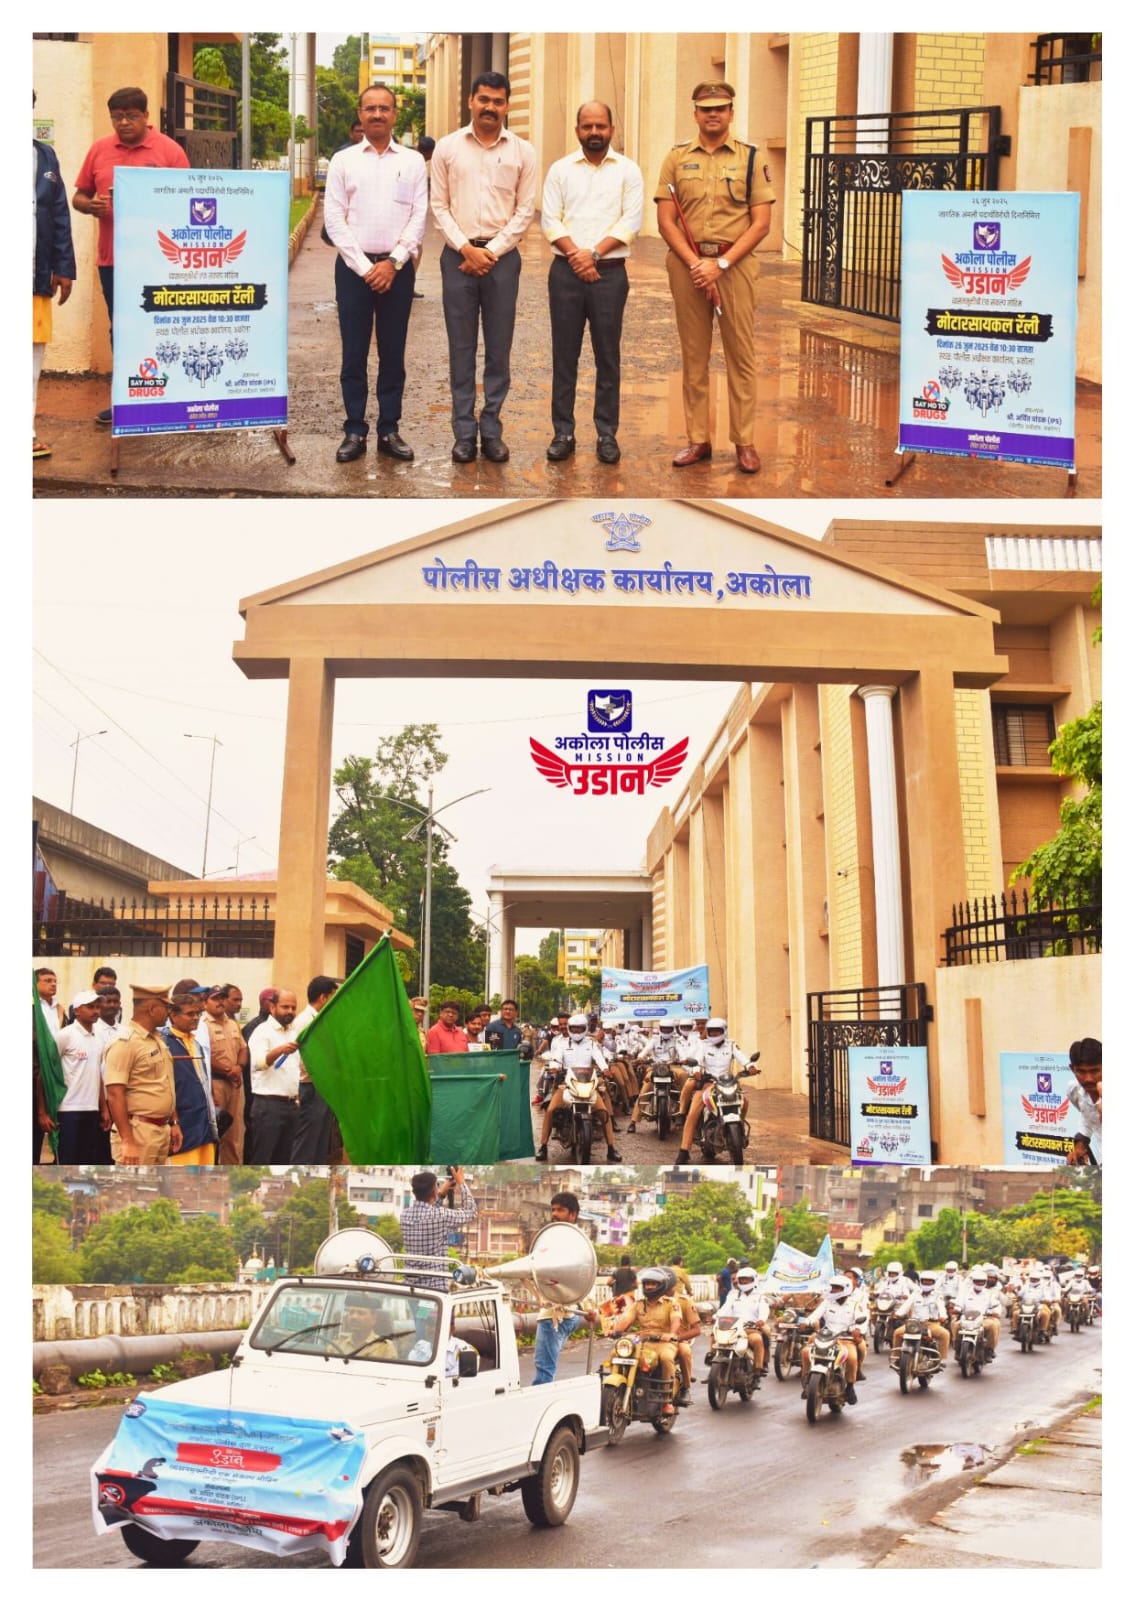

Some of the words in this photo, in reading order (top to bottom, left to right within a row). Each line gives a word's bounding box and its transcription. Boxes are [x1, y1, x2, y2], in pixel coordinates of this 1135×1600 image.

[171, 226, 202, 240] अकोला
[204, 226, 233, 240] पोलीस
[180, 248, 226, 269] उडान
[954, 251, 985, 265] अकोला
[986, 251, 1016, 266] पोलीस
[966, 266, 1007, 274] MISSION
[963, 273, 1009, 295] उडान
[152, 286, 230, 306] मोटारसायकल
[232, 285, 255, 304] रॅली
[192, 316, 207, 324] 2025
[936, 311, 1014, 334] मोटारसायकल
[1015, 314, 1040, 335] रॅली
[974, 342, 988, 351] 2025
[1000, 344, 1016, 352] 10:30
[128, 387, 164, 398] DRUGS
[914, 400, 927, 408] SAY
[937, 402, 946, 410] TO
[913, 410, 946, 420] DRUGS
[422, 558, 500, 590] पोलीस
[510, 560, 606, 595] अधीक्षक
